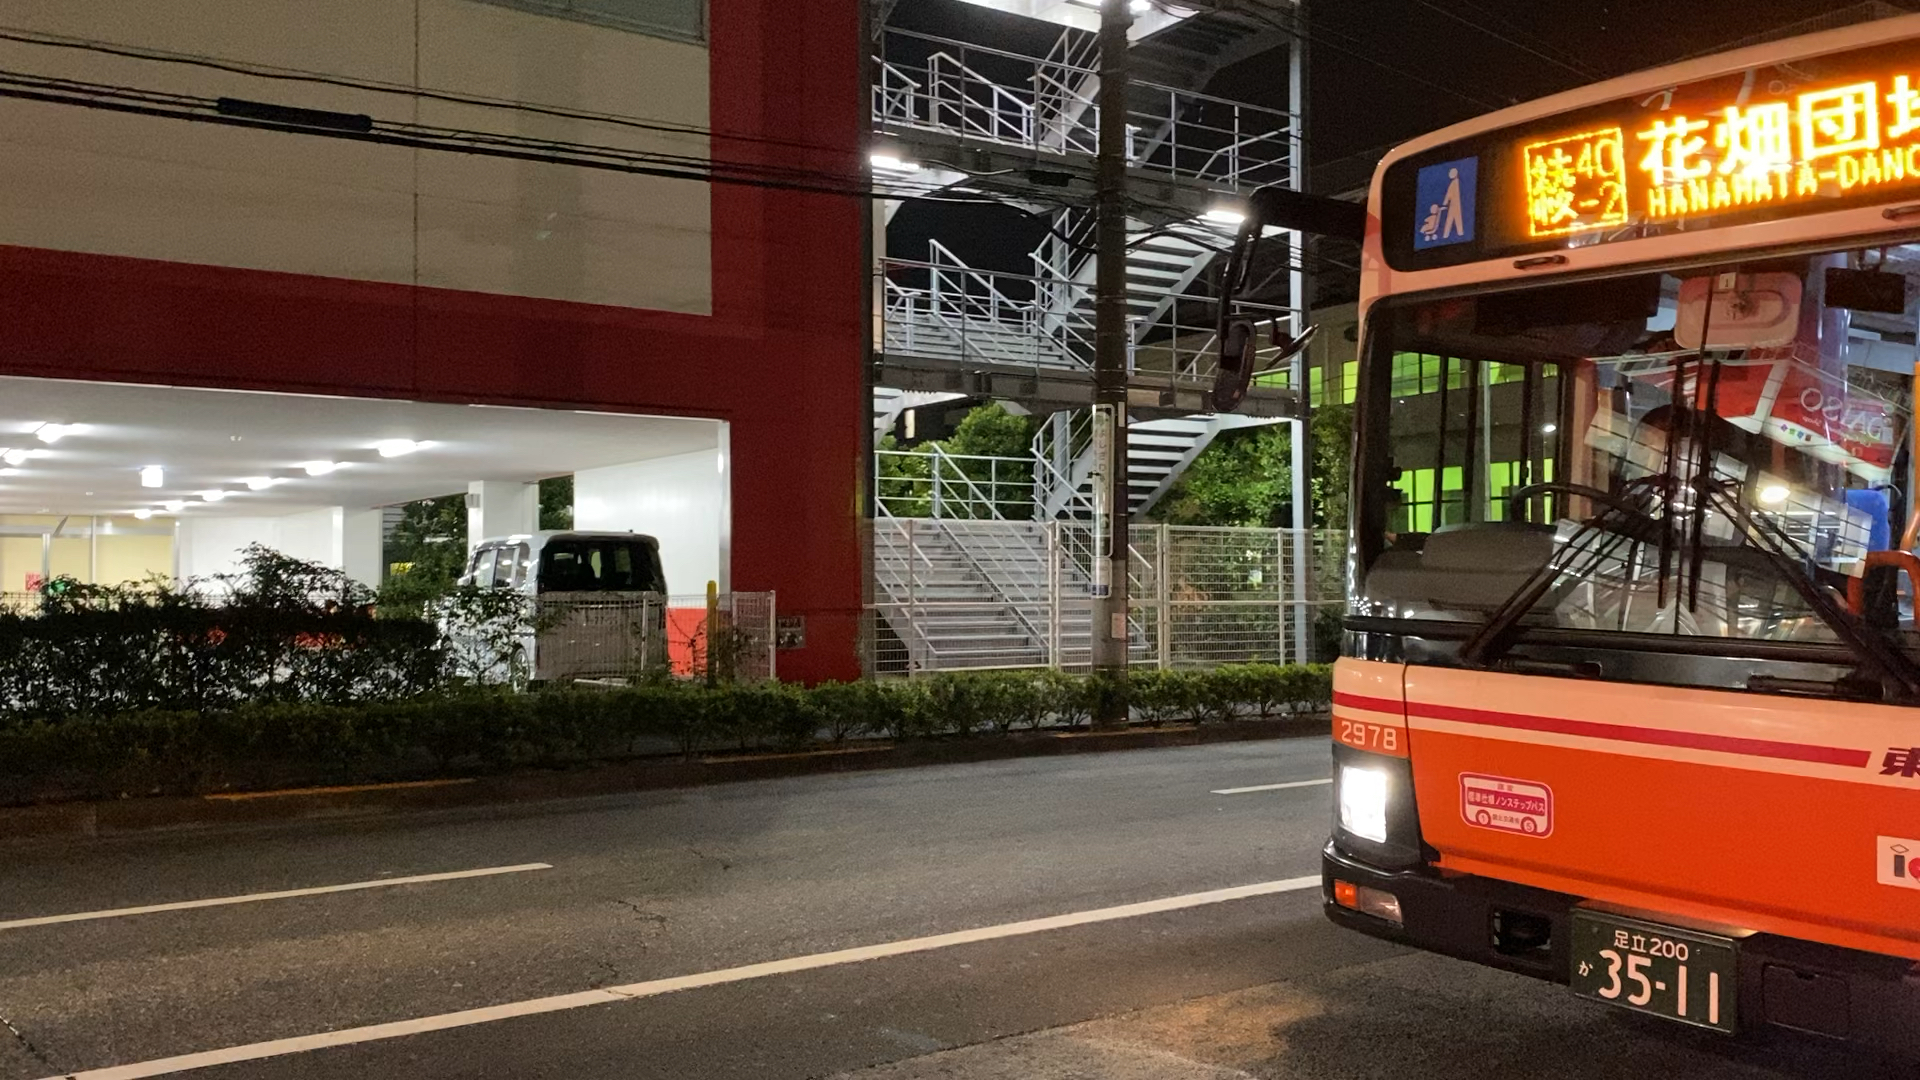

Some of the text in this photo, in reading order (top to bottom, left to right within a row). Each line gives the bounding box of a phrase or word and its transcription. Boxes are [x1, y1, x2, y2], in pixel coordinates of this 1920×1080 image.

[1341, 720, 1397, 751] 2978
[1613, 929, 1689, 961] 足立 200
[1578, 949, 1719, 1025] か 35-11
